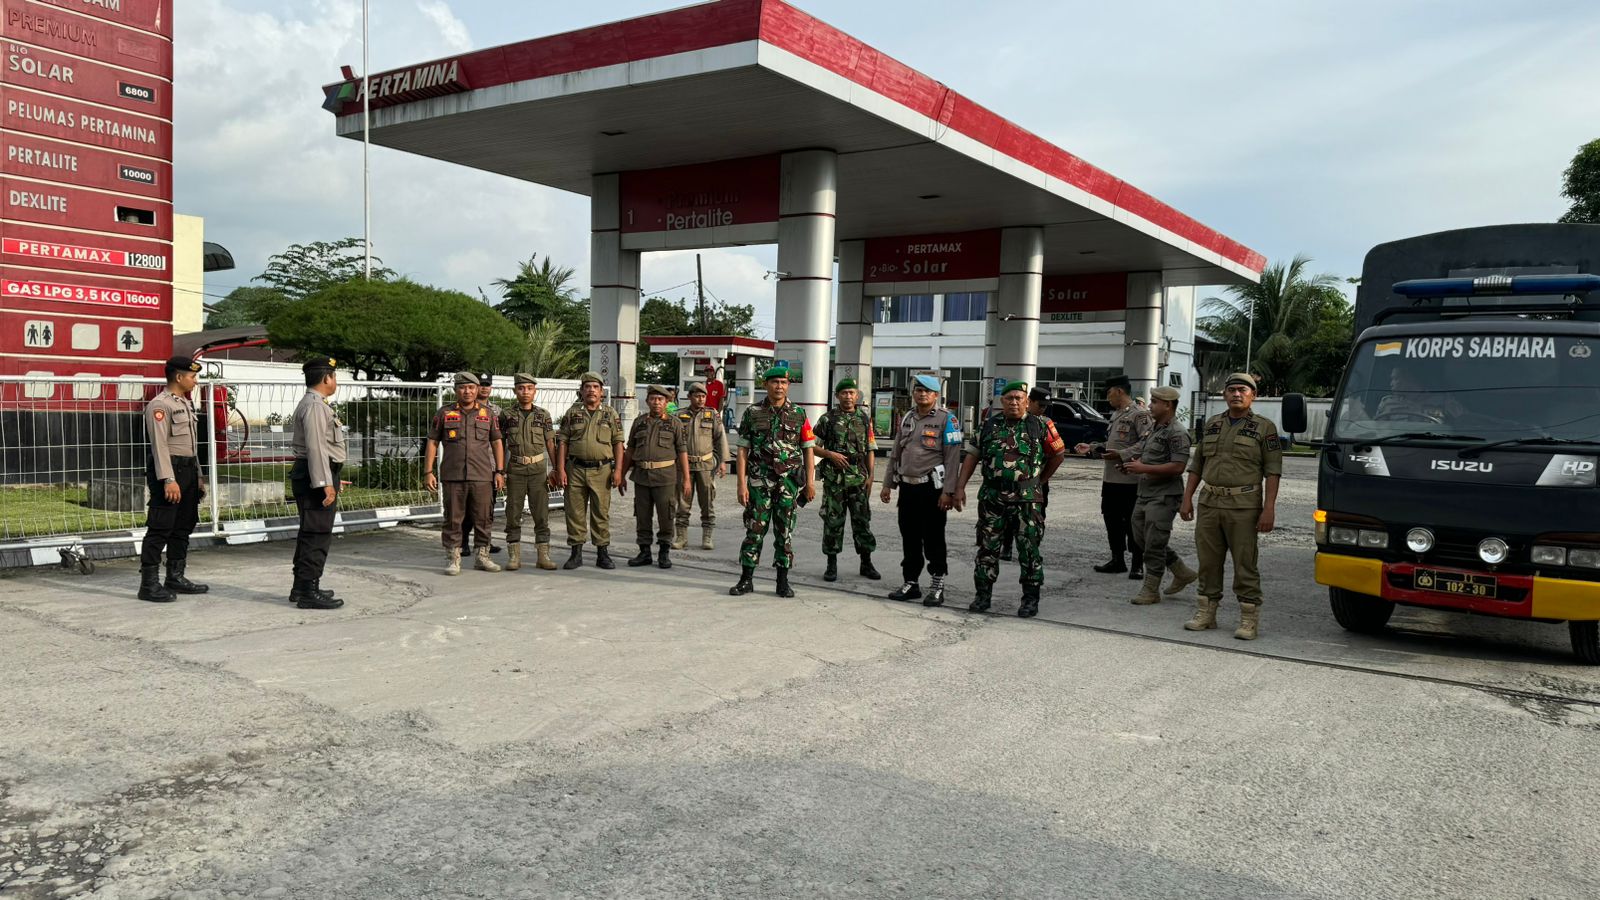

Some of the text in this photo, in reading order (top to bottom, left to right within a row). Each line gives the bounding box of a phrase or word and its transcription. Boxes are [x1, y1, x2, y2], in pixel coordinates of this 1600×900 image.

[8, 9, 97, 47] PREMIUM
[9, 44, 28, 55] BIO
[9, 55, 74, 83] SOLAR
[356, 60, 458, 102] PERTAMINA
[125, 86, 149, 99] 6800
[8, 100, 156, 144] PELUMAS PERTAMINA
[8, 145, 78, 172] PERTALITE
[123, 168, 152, 182] 10000
[9, 190, 67, 213] DEXLITE
[666, 208, 733, 231] Pertalite
[19, 241, 112, 263] PERTAMAX
[907, 243, 962, 254] PERTAMAX
[129, 253, 162, 269] 12800
[903, 259, 948, 274] Solar
[7, 283, 121, 303] GAS LPG 3,5 KG
[126, 293, 159, 306] 16000
[1048, 288, 1088, 301] Solar
[1050, 312, 1083, 321] DEXLITE
[1405, 337, 1556, 359] KORPS SABHARA
[1431, 459, 1493, 473] ISUZU
[1561, 461, 1594, 473] HD
